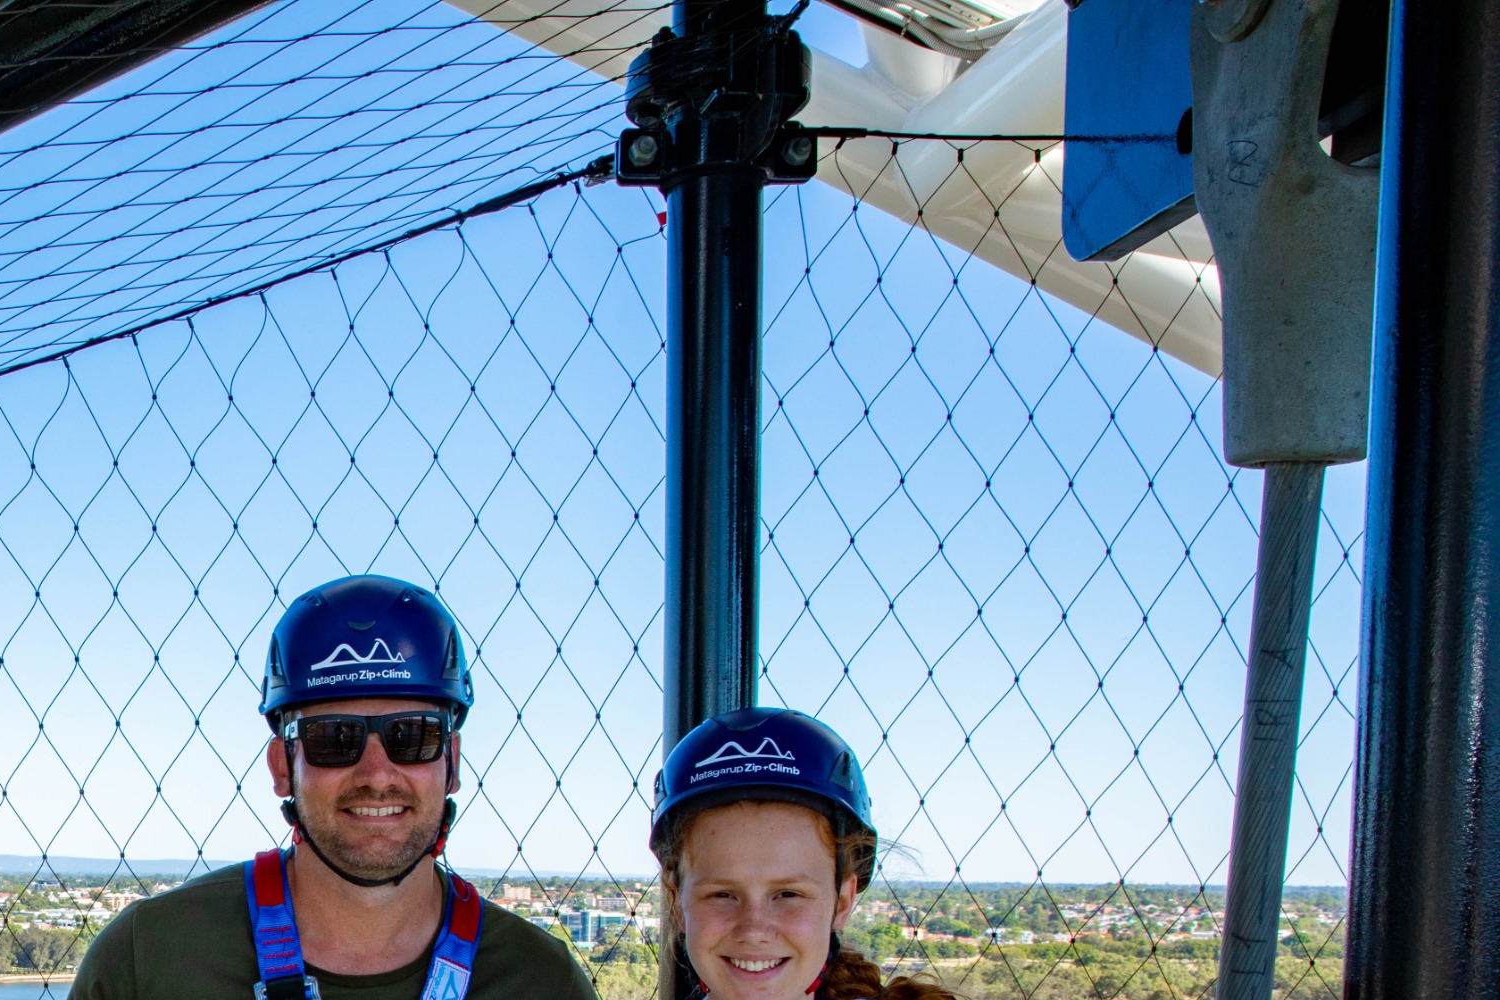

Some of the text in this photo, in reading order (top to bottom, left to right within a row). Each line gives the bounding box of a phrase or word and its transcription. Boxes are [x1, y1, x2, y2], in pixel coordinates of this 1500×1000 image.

[307, 669, 411, 688] Matagarup Zip+Climb
[690, 763, 800, 784] Matagarup Zip+Climb
